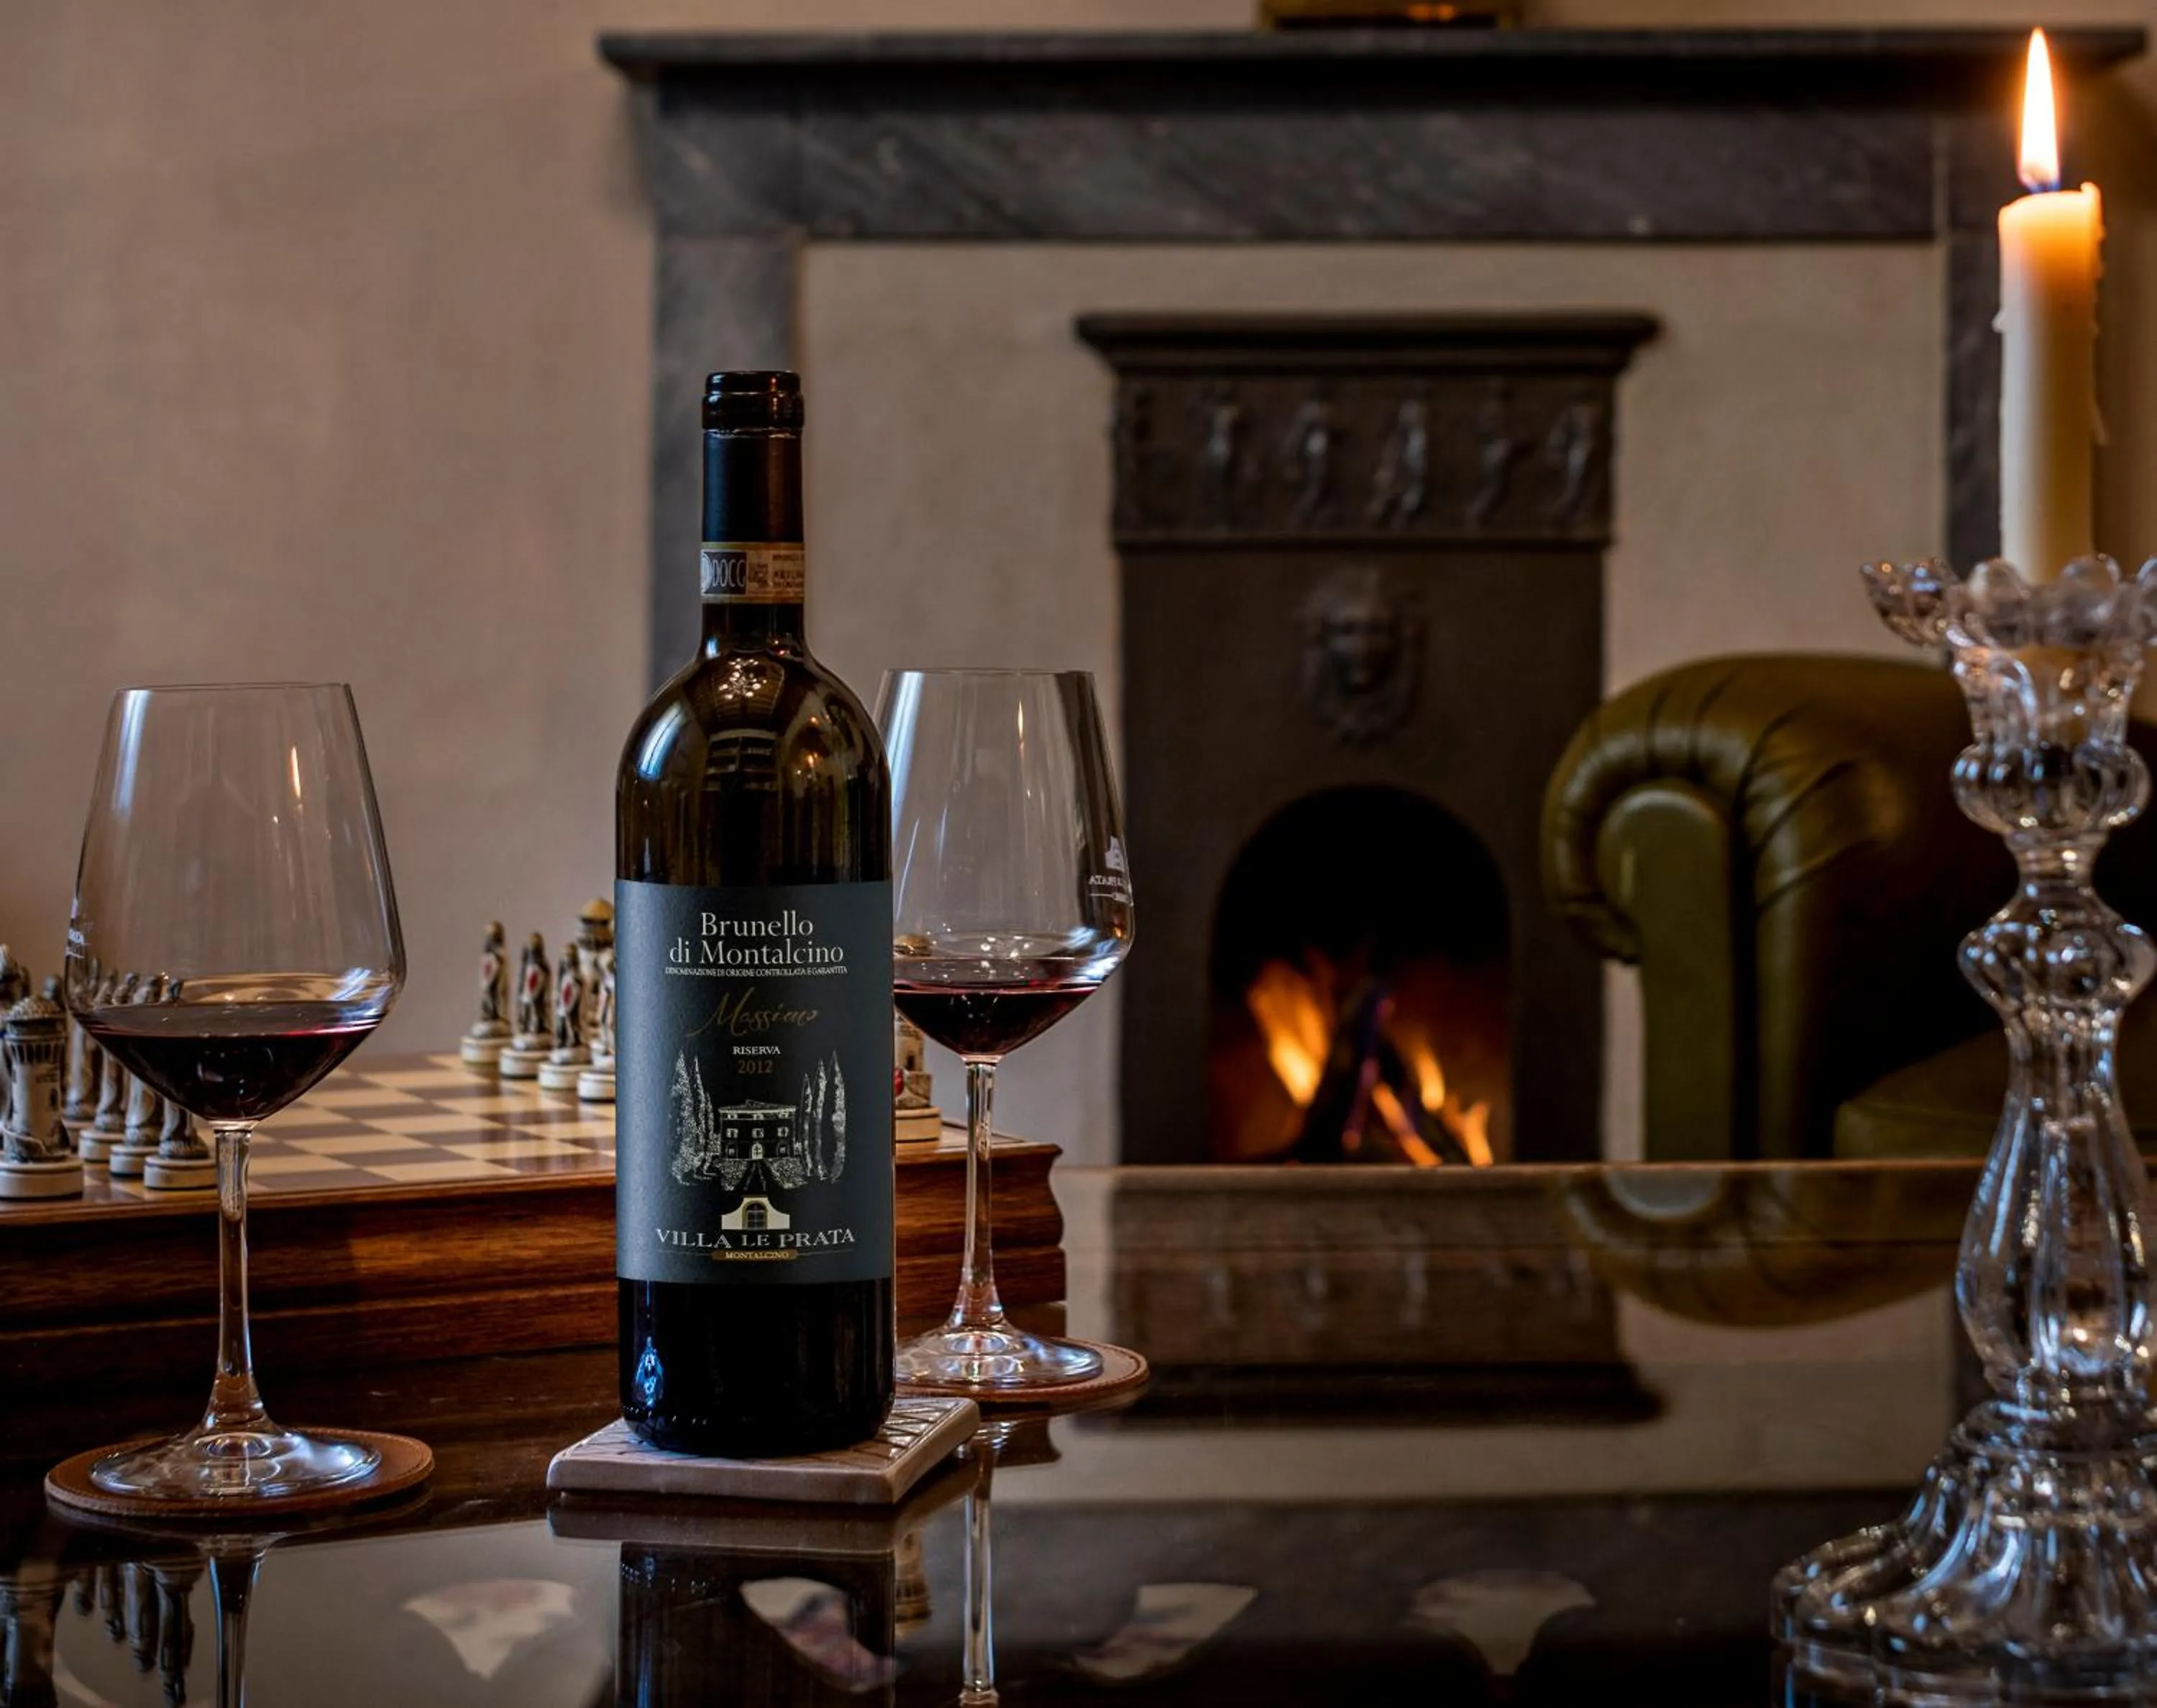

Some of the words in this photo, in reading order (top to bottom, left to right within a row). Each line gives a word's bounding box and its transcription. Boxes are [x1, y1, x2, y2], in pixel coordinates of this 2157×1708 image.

[701, 910, 814, 937] Brunello
[669, 937, 690, 963] di
[700, 938, 844, 965] Montalcino
[686, 986, 818, 1038] Massimo
[733, 1046, 782, 1055] RISERVA
[738, 1060, 774, 1074] 2012
[655, 1229, 732, 1249] VILLA
[741, 1234, 771, 1247] LE
[779, 1228, 855, 1248] PRATA
